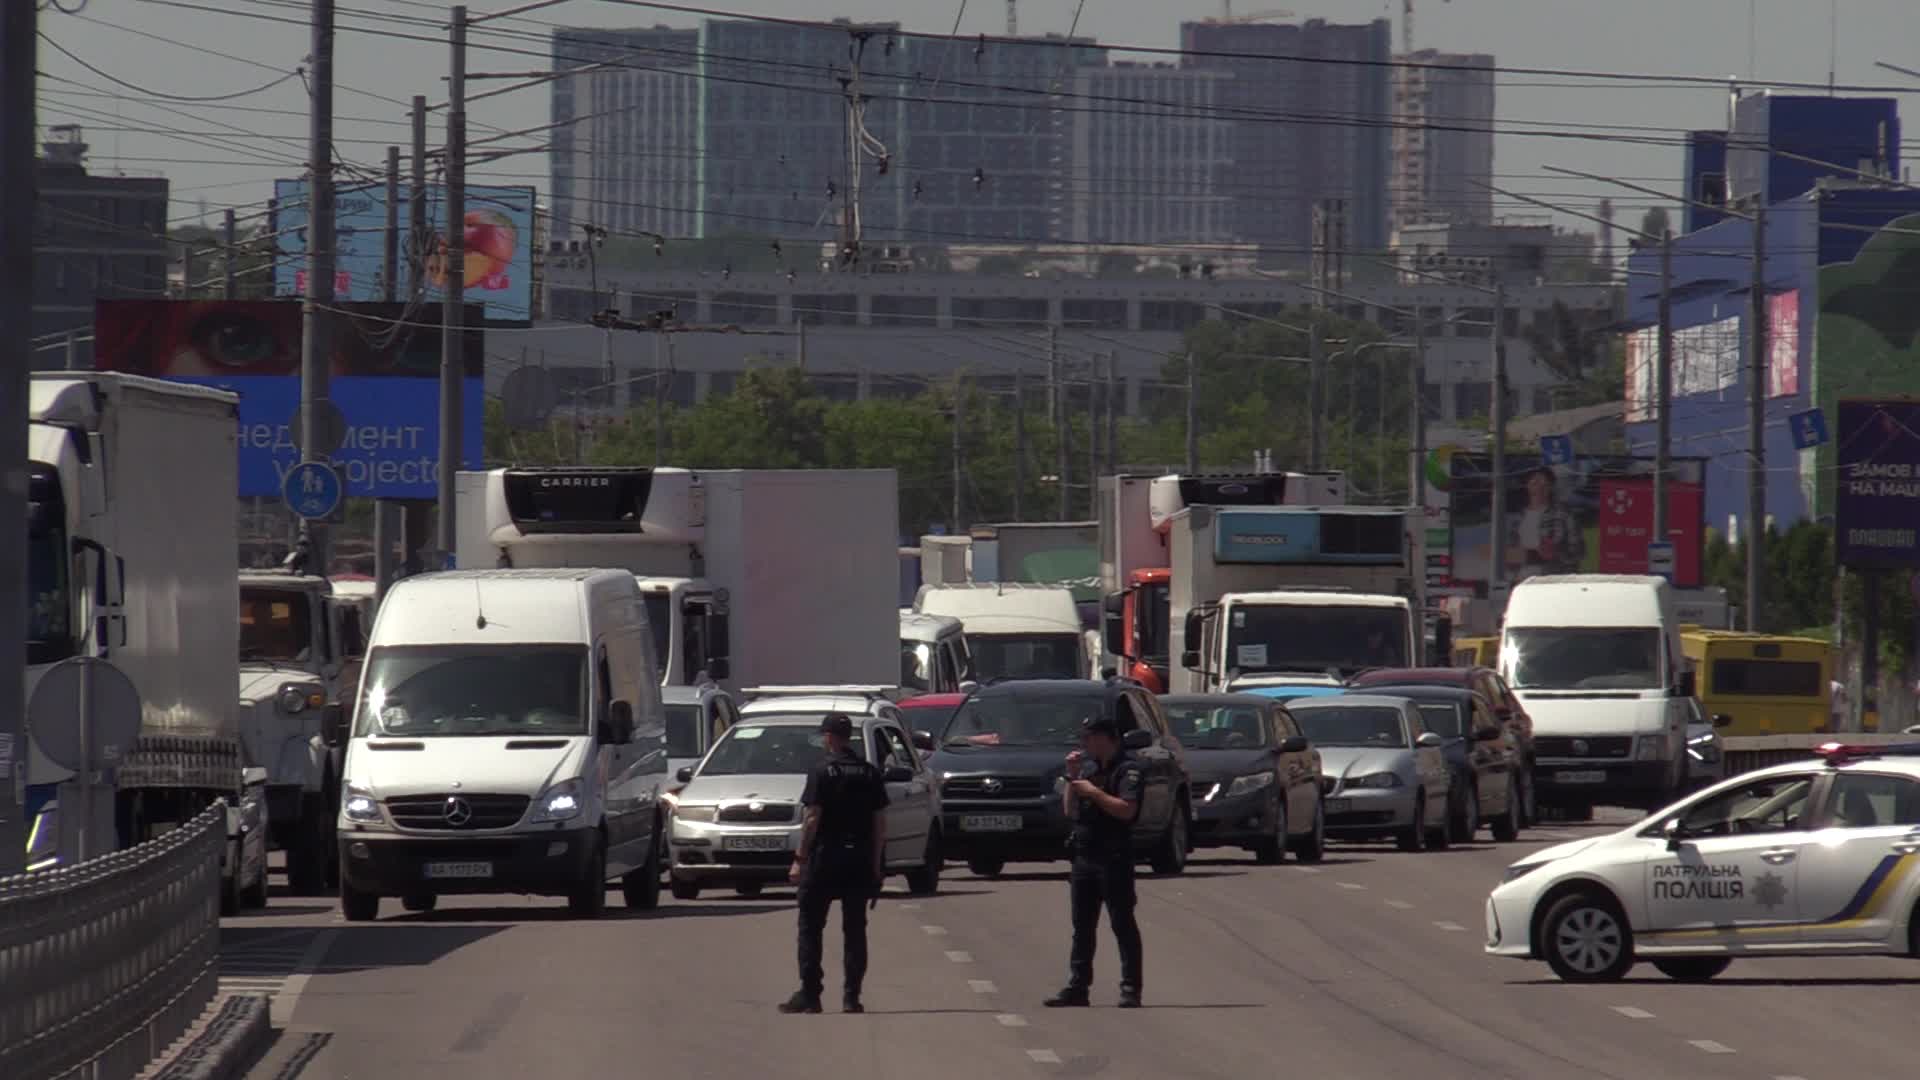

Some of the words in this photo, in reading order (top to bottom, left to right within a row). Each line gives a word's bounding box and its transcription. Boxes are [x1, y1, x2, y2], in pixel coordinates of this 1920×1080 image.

[236, 424, 424, 453] недмент
[541, 478, 609, 487] CARRIER
[1653, 864, 1741, 878] ПАТРУЛЬНА
[1653, 880, 1744, 900] ПОЛІЦІЯ
